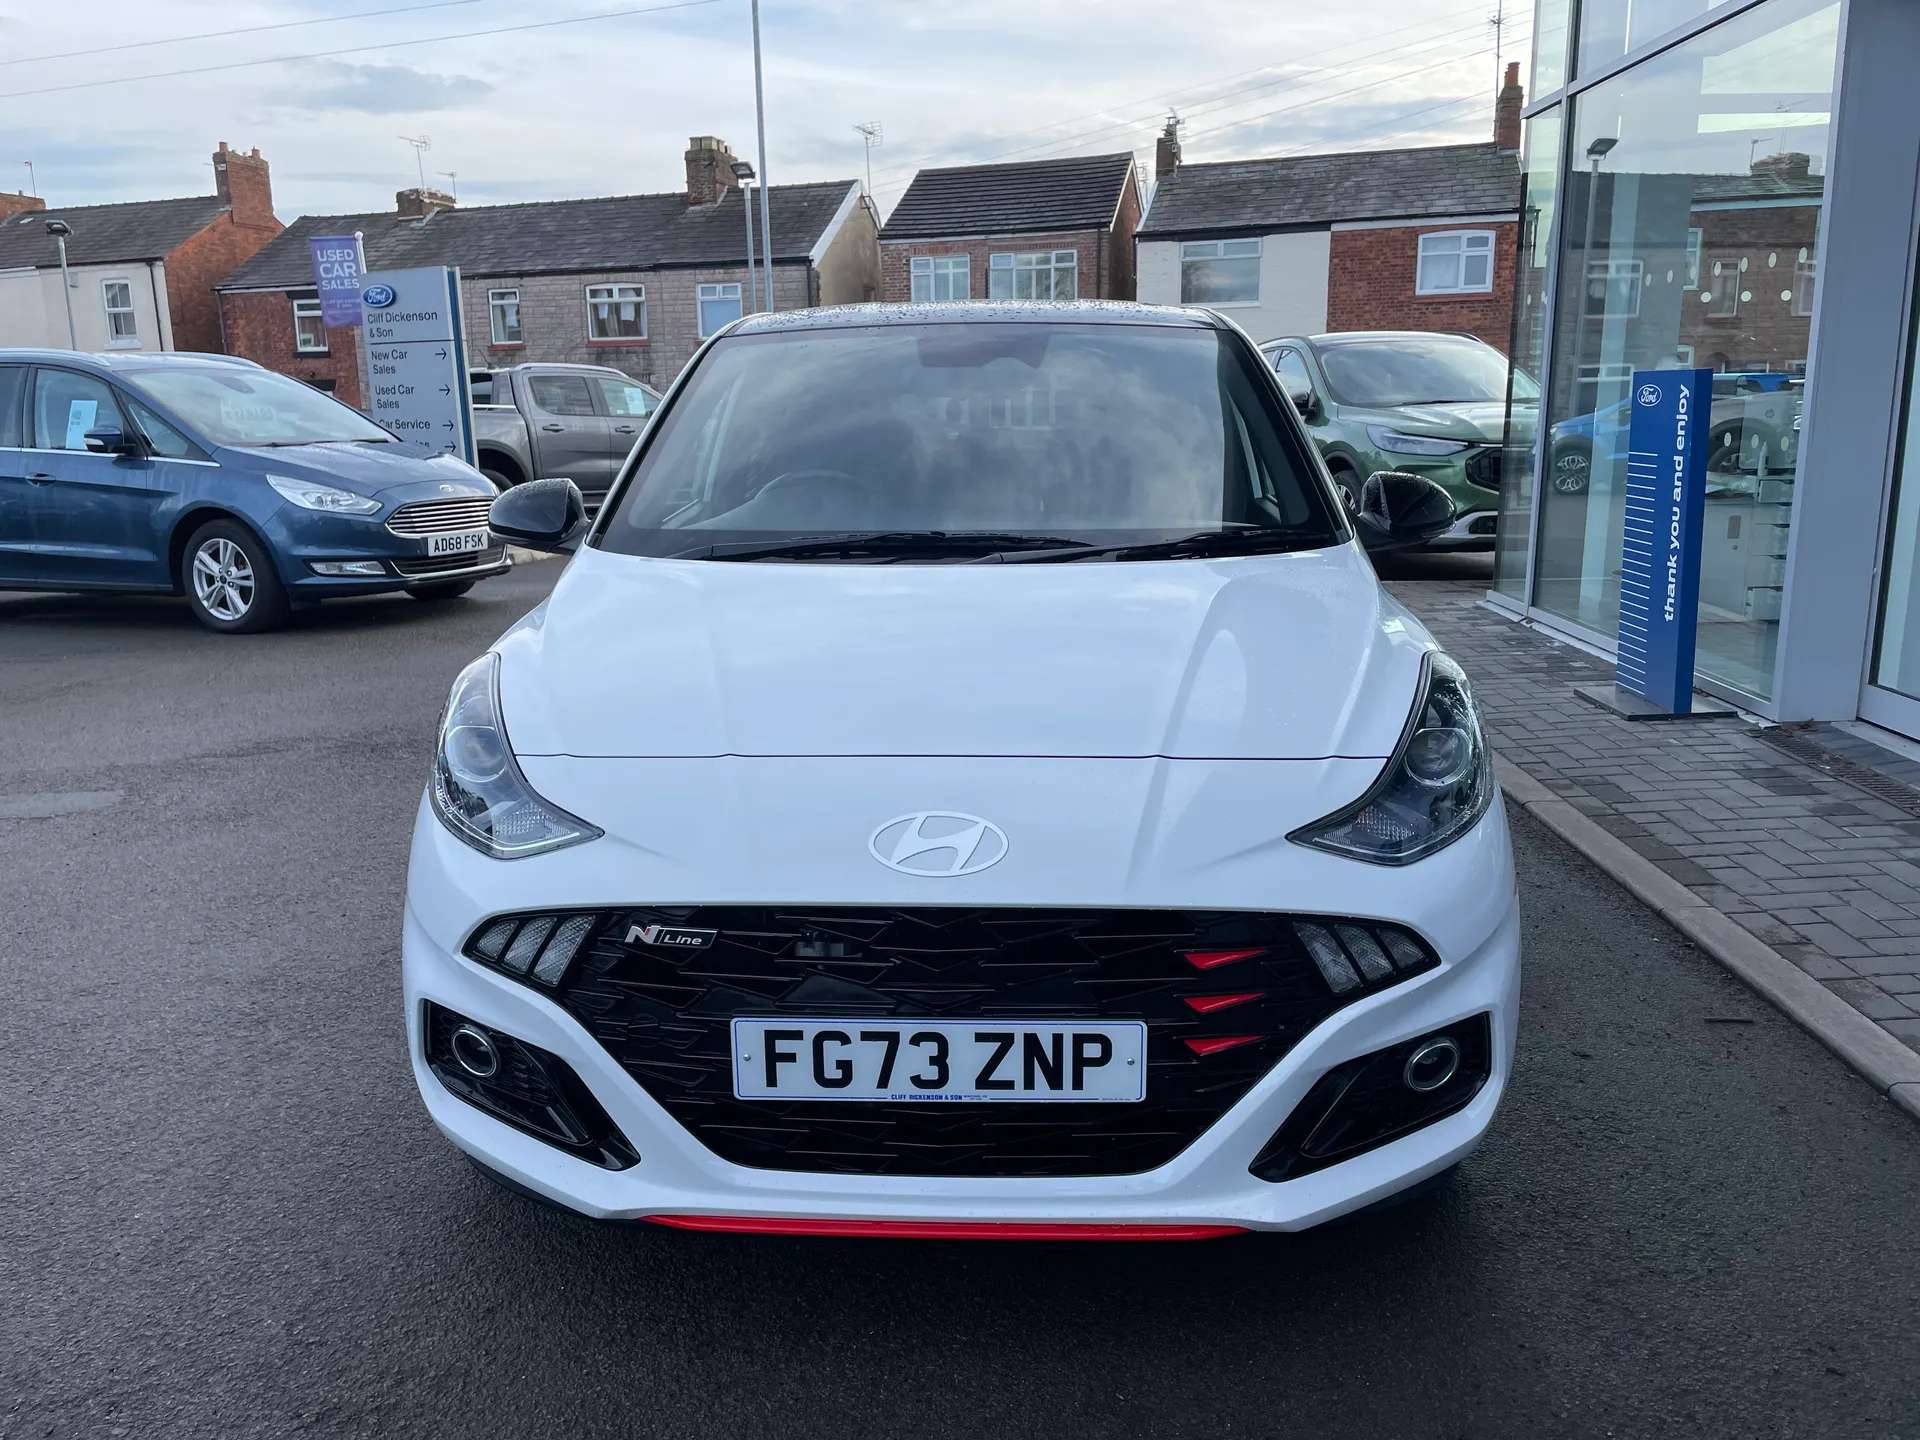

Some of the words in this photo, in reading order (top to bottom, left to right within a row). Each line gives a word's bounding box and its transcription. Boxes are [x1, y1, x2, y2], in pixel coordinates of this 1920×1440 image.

[317, 249, 354, 261] USED
[320, 262, 357, 278] CAR
[321, 279, 360, 290] SALES
[367, 312, 383, 324] Cliff
[385, 311, 438, 323] Dickenson
[369, 328, 375, 338] &
[376, 327, 393, 338] Son
[371, 351, 390, 361] New
[391, 349, 408, 360] Car
[373, 364, 396, 375] Sales
[375, 384, 396, 395] Used
[397, 384, 415, 395] Car
[377, 398, 400, 409] Sales
[1676, 383, 1690, 451] enjoy
[394, 418, 431, 430] Service
[1673, 455, 1684, 503] and
[1669, 507, 1683, 550] you
[433, 536, 462, 553] AD68
[464, 533, 484, 550] FSK
[1664, 553, 1678, 623] thank
[663, 934, 703, 945] Line
[763, 1028, 951, 1091] FG73
[973, 1031, 1114, 1092] ZNP
[890, 1093, 907, 1101] CLIFF
[950, 1093, 963, 1101] SON
